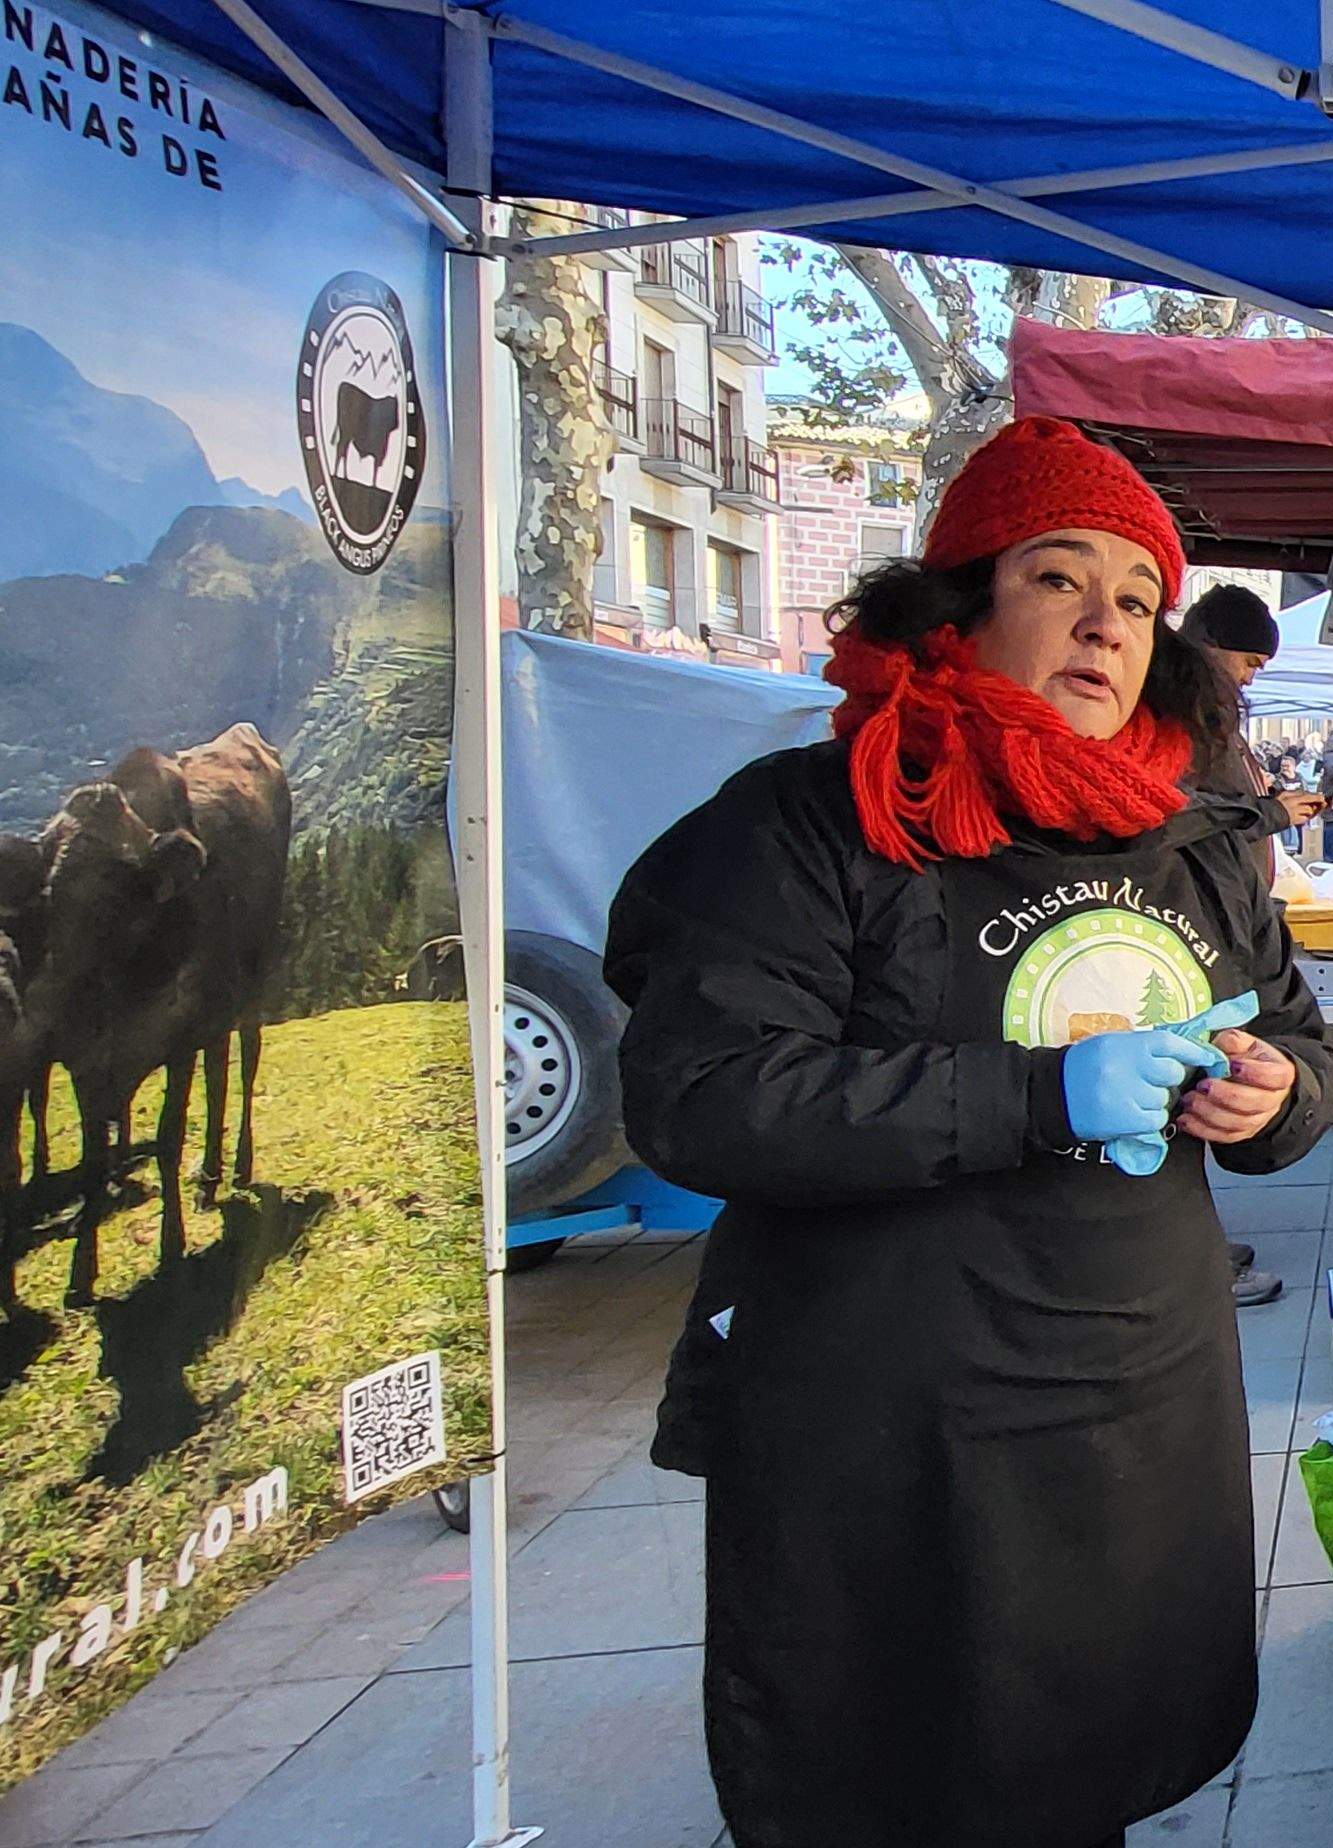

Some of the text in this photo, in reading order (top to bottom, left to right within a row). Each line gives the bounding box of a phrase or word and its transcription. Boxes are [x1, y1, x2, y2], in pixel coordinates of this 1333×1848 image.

[3, 65, 223, 191] AÑAS DE
[314, 484, 341, 545] BLACK
[338, 538, 371, 568] ANGUS
[978, 876, 1222, 969] Chistau Natural
